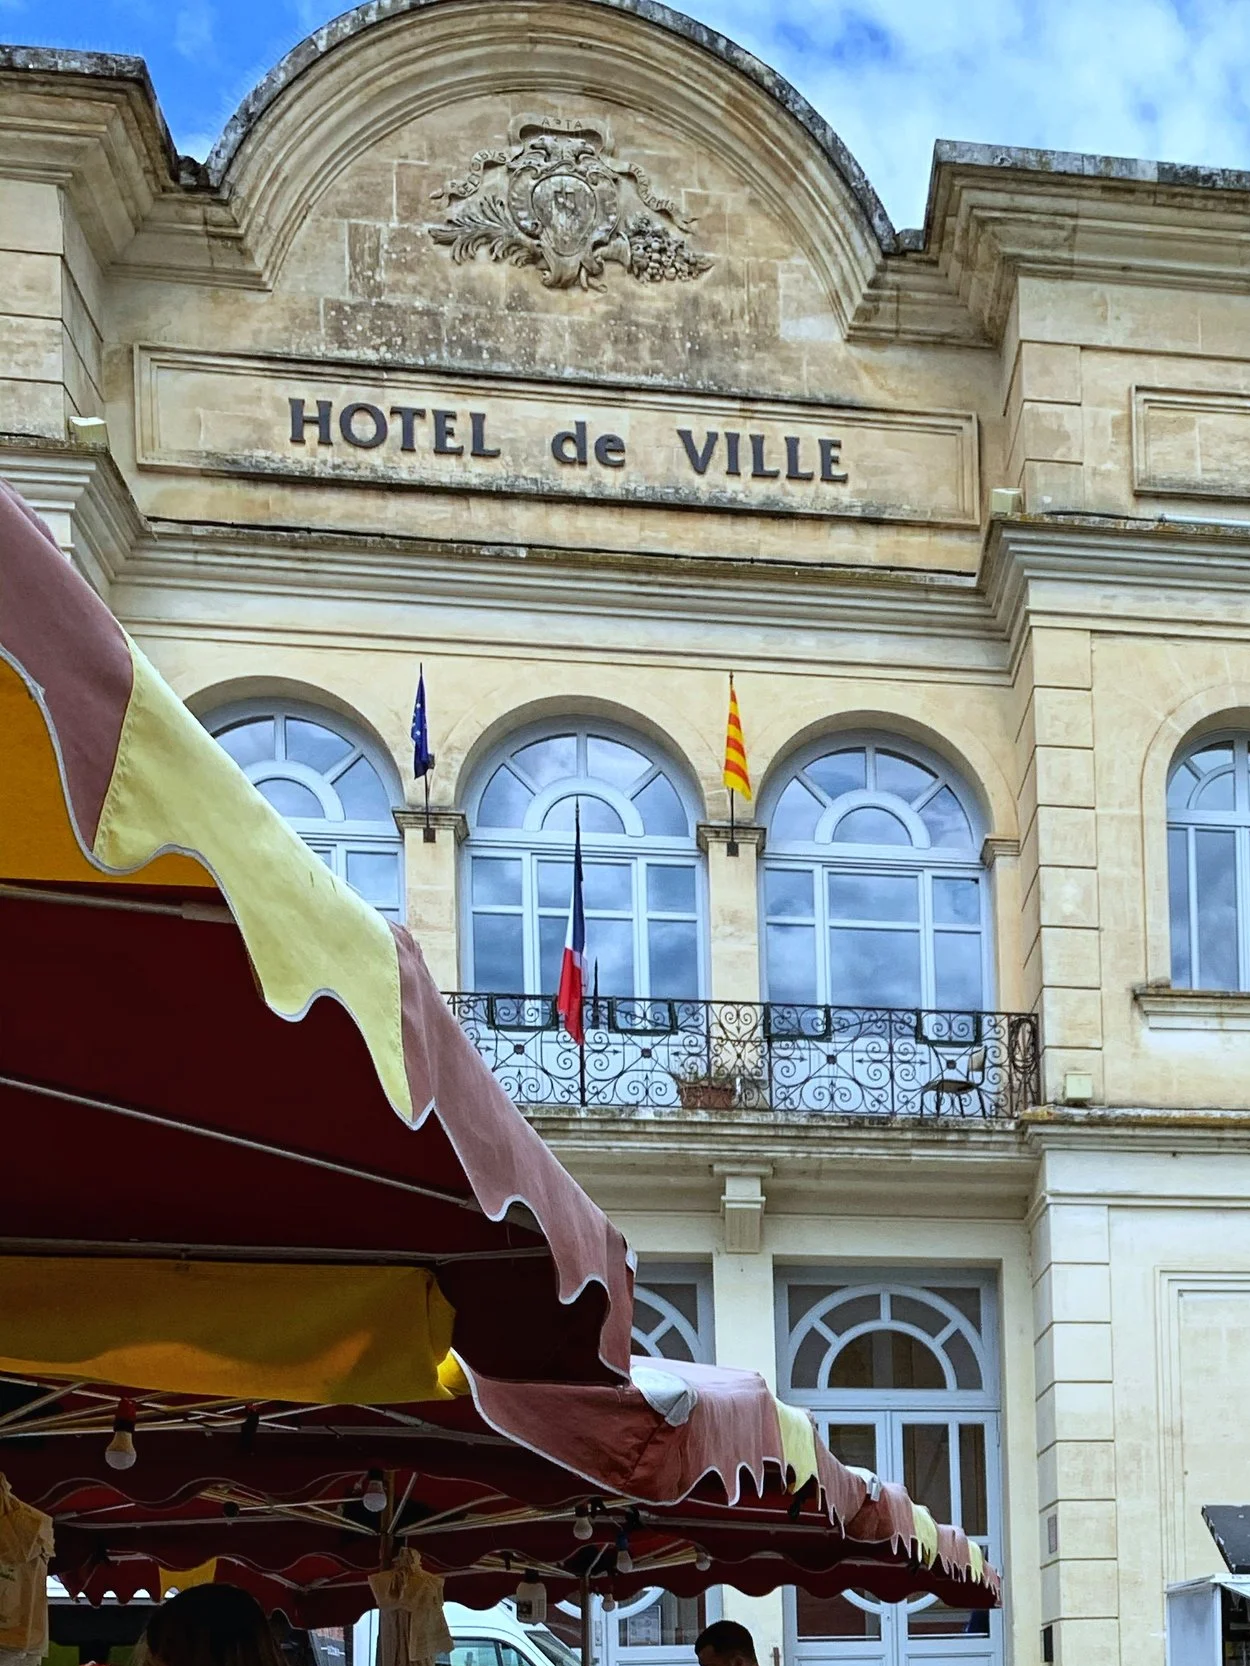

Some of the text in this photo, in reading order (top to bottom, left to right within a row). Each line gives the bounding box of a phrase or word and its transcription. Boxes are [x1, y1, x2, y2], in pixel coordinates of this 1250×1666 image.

[288, 397, 849, 483] HOTEL de VILLE
